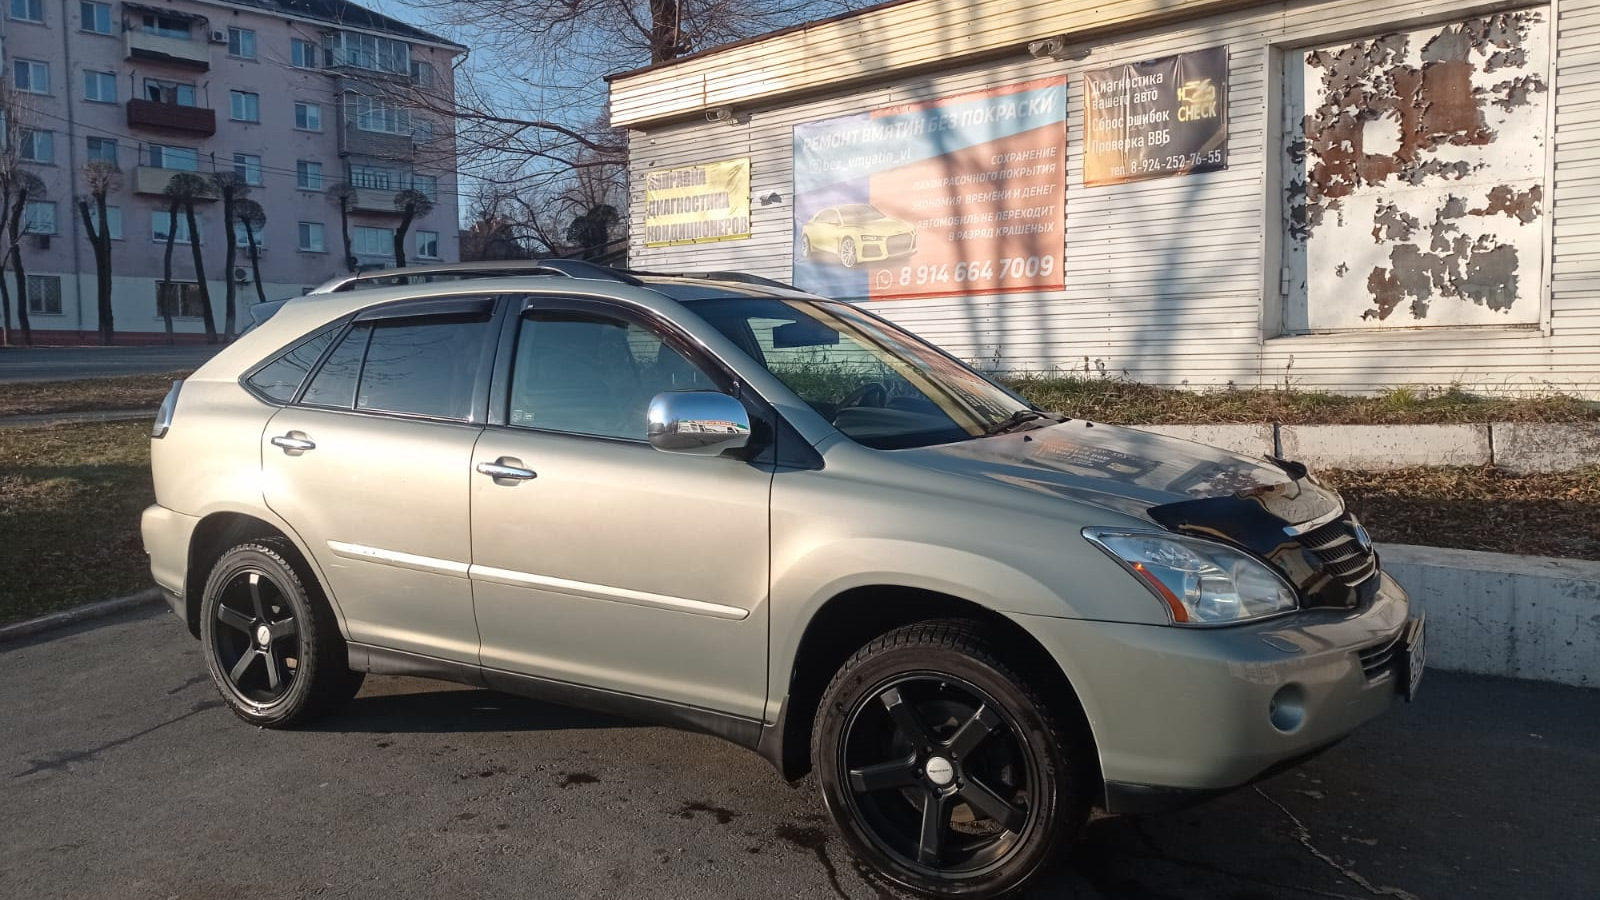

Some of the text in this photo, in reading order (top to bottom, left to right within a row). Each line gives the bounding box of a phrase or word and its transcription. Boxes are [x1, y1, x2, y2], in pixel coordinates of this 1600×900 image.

[1091, 73, 1163, 96] Диагностика
[1134, 89, 1158, 104] авто
[802, 94, 1056, 152] РЕМОНТ ВМЯТИН БЕЗ ПОКРАСКИ
[1092, 109, 1170, 132] Сброс ошибок
[1177, 101, 1217, 122] CHECK
[1092, 128, 1170, 156] Проверка ВВБ
[990, 147, 1057, 166] СОХРАНЕНИЕ
[1130, 149, 1221, 174] 8-924-252-76-55
[912, 163, 1056, 191] ЛАКОКРАСОЧНОГО ПОКРЫТИЯ
[648, 192, 729, 218] ДИАГНОСТИКА
[911, 184, 1056, 210] ЭКОНОМИЯ ВРЕМЕНИ И ДЕНЕГ
[647, 217, 748, 241] КОНДИЦИОНЕРОВ
[917, 205, 1056, 229] АВТОМОБИЛЬ НЕ ПЕРЕХОДИТ
[948, 222, 1056, 241] В РАЗРЯД КРАШЕНЫХ
[900, 255, 1055, 286] 8 914 664 7009
